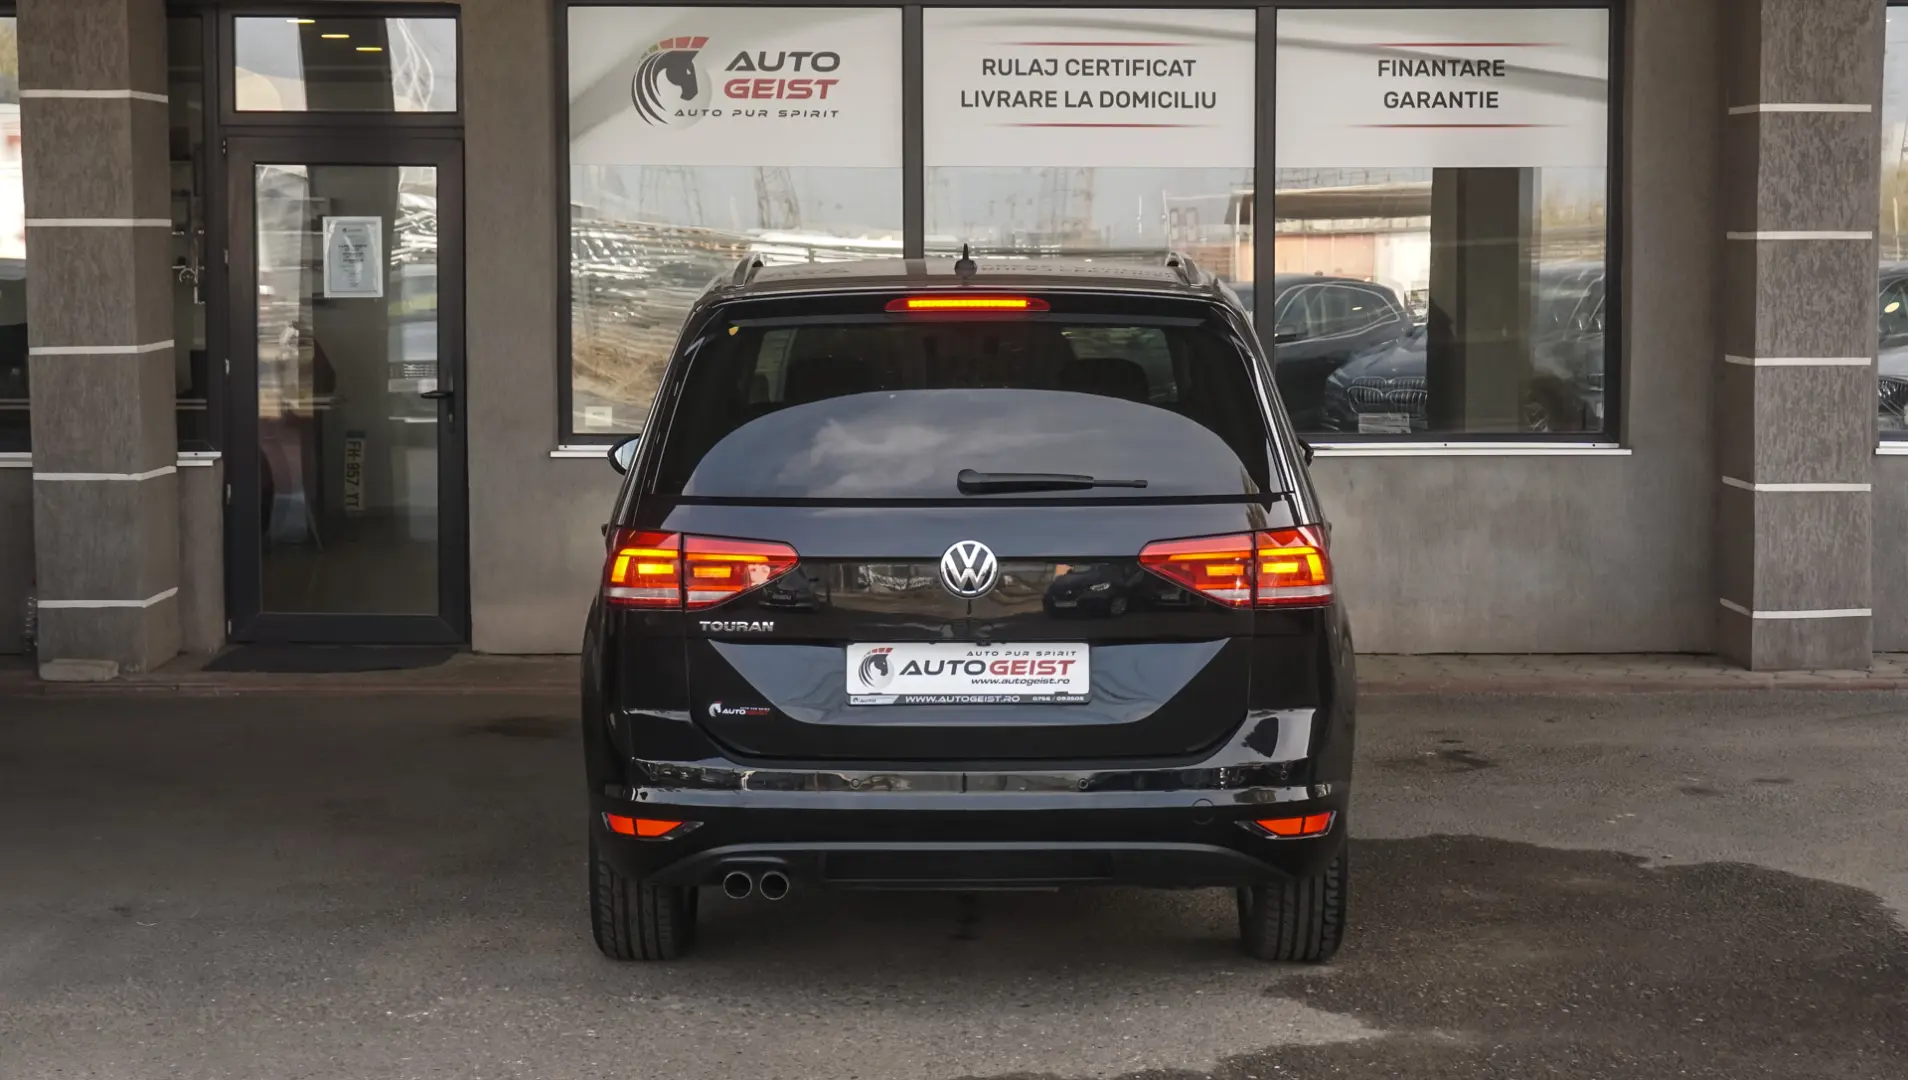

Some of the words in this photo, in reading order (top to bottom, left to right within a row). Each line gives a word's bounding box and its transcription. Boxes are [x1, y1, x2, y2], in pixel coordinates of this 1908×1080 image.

[724, 51, 841, 72] AUTO
[982, 58, 1059, 76] RULAJ
[1064, 59, 1197, 77] CERTIFICAT
[1378, 59, 1506, 77] FINANTARE
[723, 78, 840, 99] GEIST
[960, 90, 1058, 108] LIVRARE
[1064, 90, 1094, 108] LA
[1099, 91, 1217, 109] DOMICILIU
[1383, 91, 1499, 109] GARANTIE
[674, 109, 723, 117] AUTO
[731, 109, 768, 118] PUR
[778, 109, 840, 118] SPIRIT
[699, 621, 775, 632] TOURAN
[971, 678, 1070, 686] www.autogeist.ro
